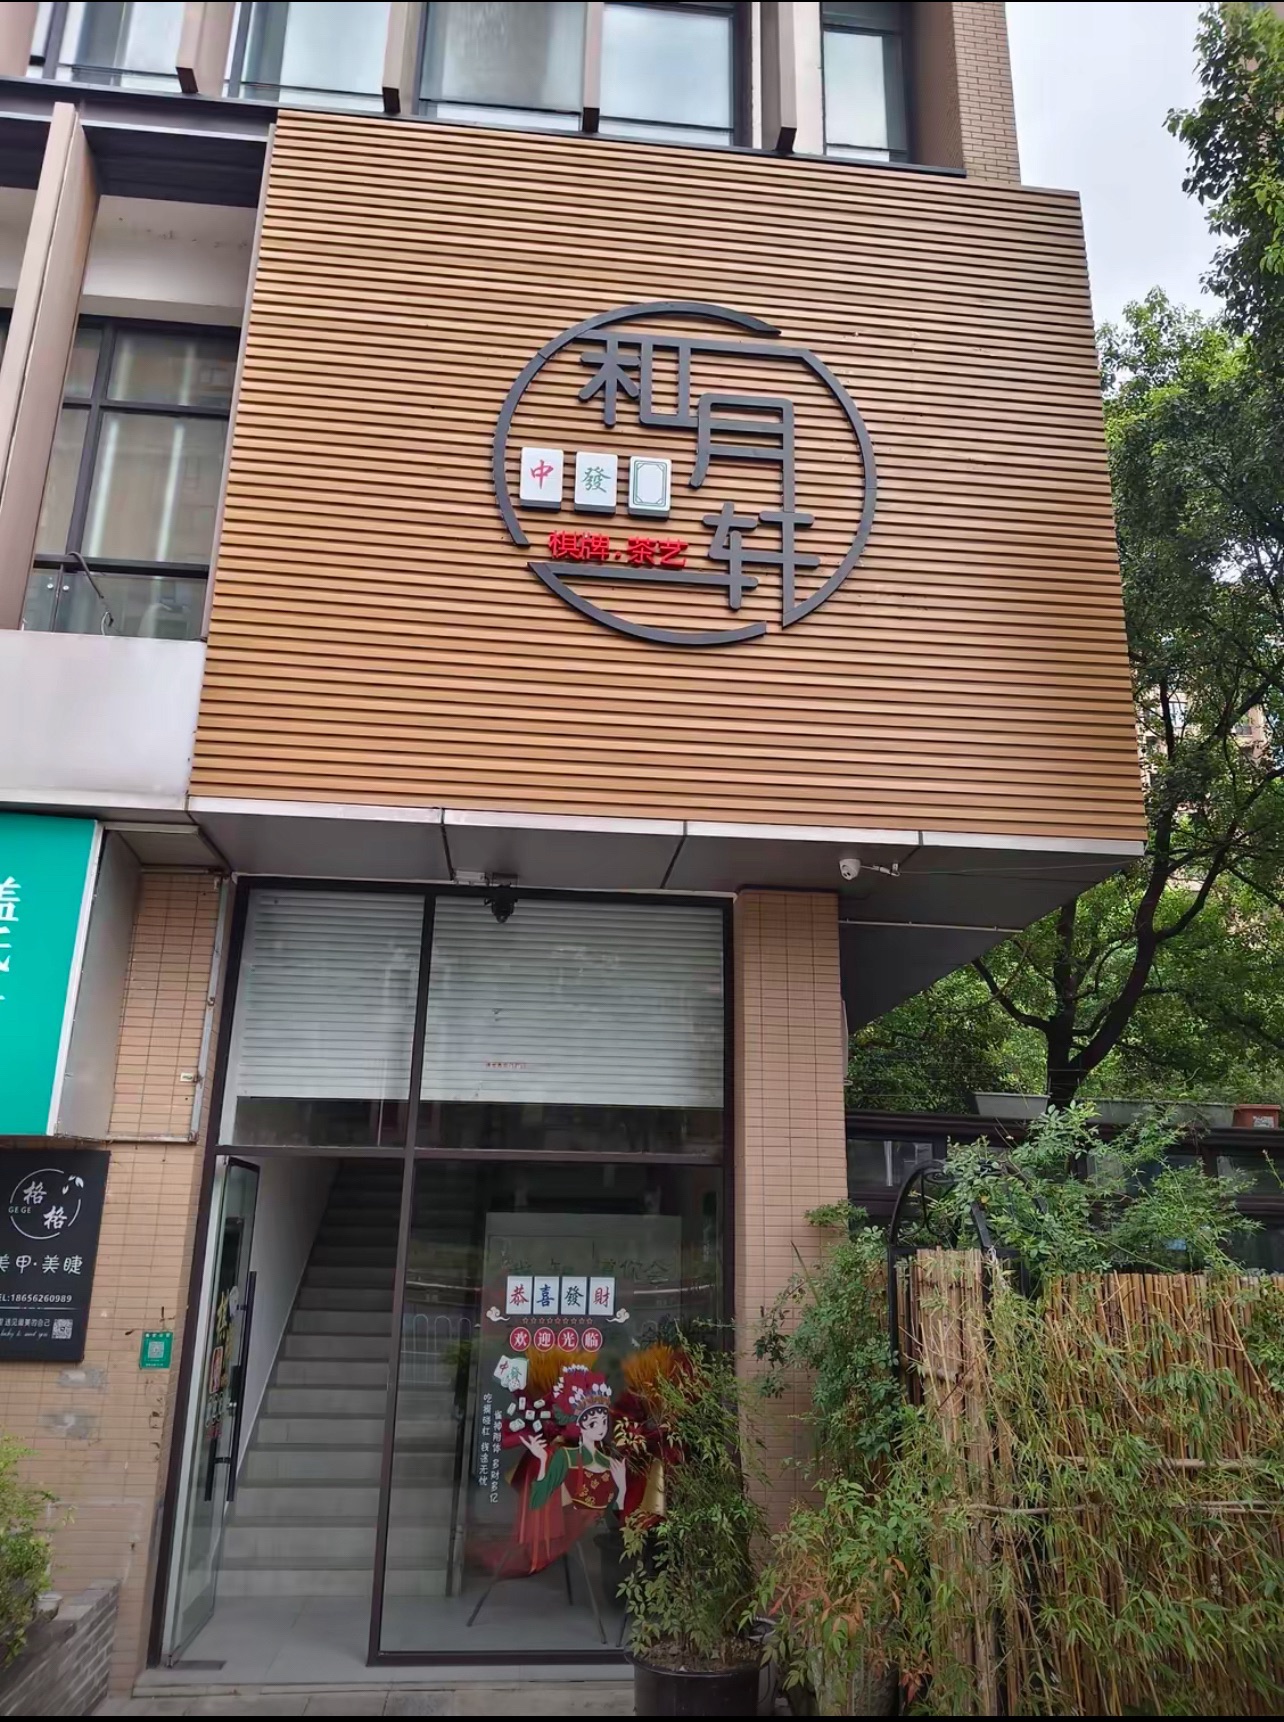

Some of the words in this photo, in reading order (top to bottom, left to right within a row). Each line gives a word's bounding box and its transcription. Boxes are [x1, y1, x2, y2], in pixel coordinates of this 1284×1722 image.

[509, 1283, 611, 1308] 恭喜發財
[513, 1331, 600, 1347] 欢迎光临
